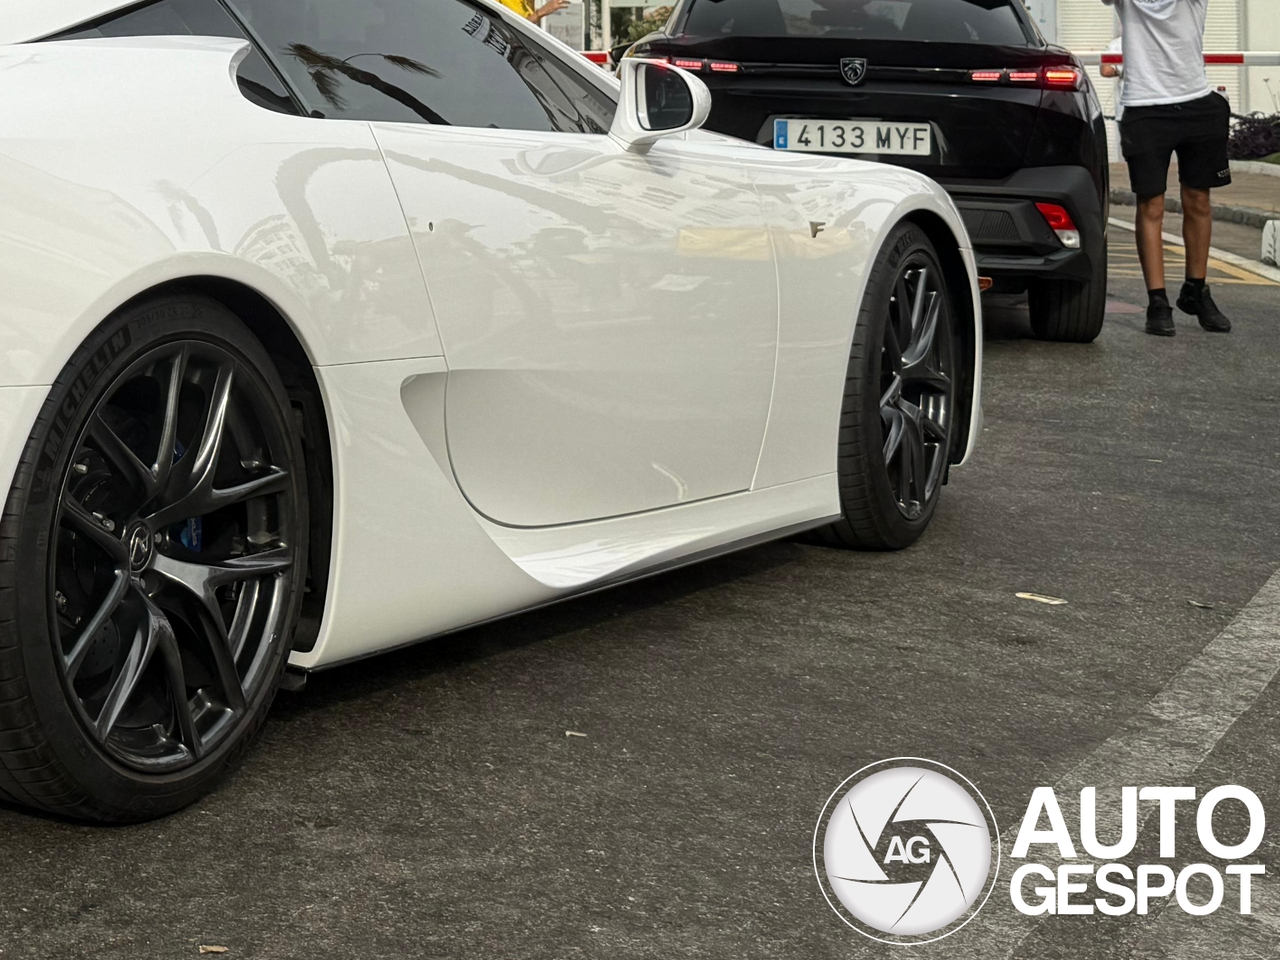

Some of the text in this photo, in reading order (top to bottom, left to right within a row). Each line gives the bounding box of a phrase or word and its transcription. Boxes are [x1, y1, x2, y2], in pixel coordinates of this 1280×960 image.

[797, 124, 928, 150] 4133 MYF
[43, 328, 128, 463] MICHELIN
